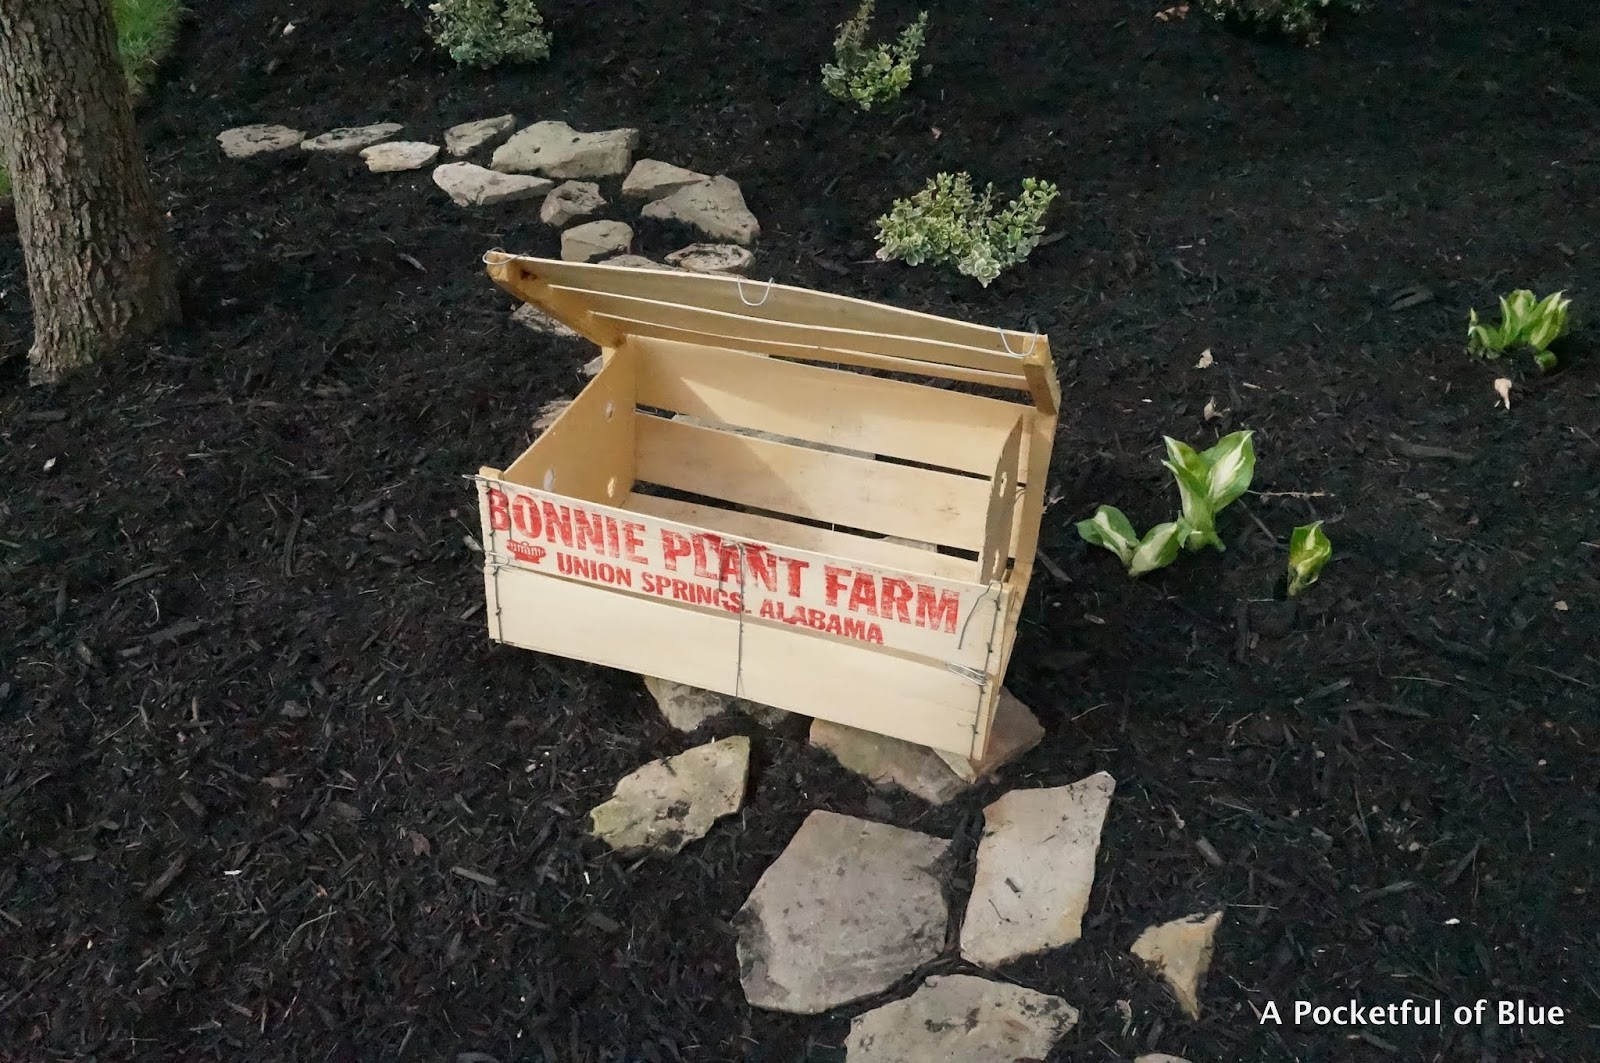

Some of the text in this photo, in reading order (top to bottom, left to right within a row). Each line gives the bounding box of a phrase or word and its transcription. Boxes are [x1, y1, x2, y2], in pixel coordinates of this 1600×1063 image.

[487, 486, 960, 634] BONNIE PLANT FARM
[556, 552, 632, 588] UNION
[760, 598, 884, 645] ALABAMA
